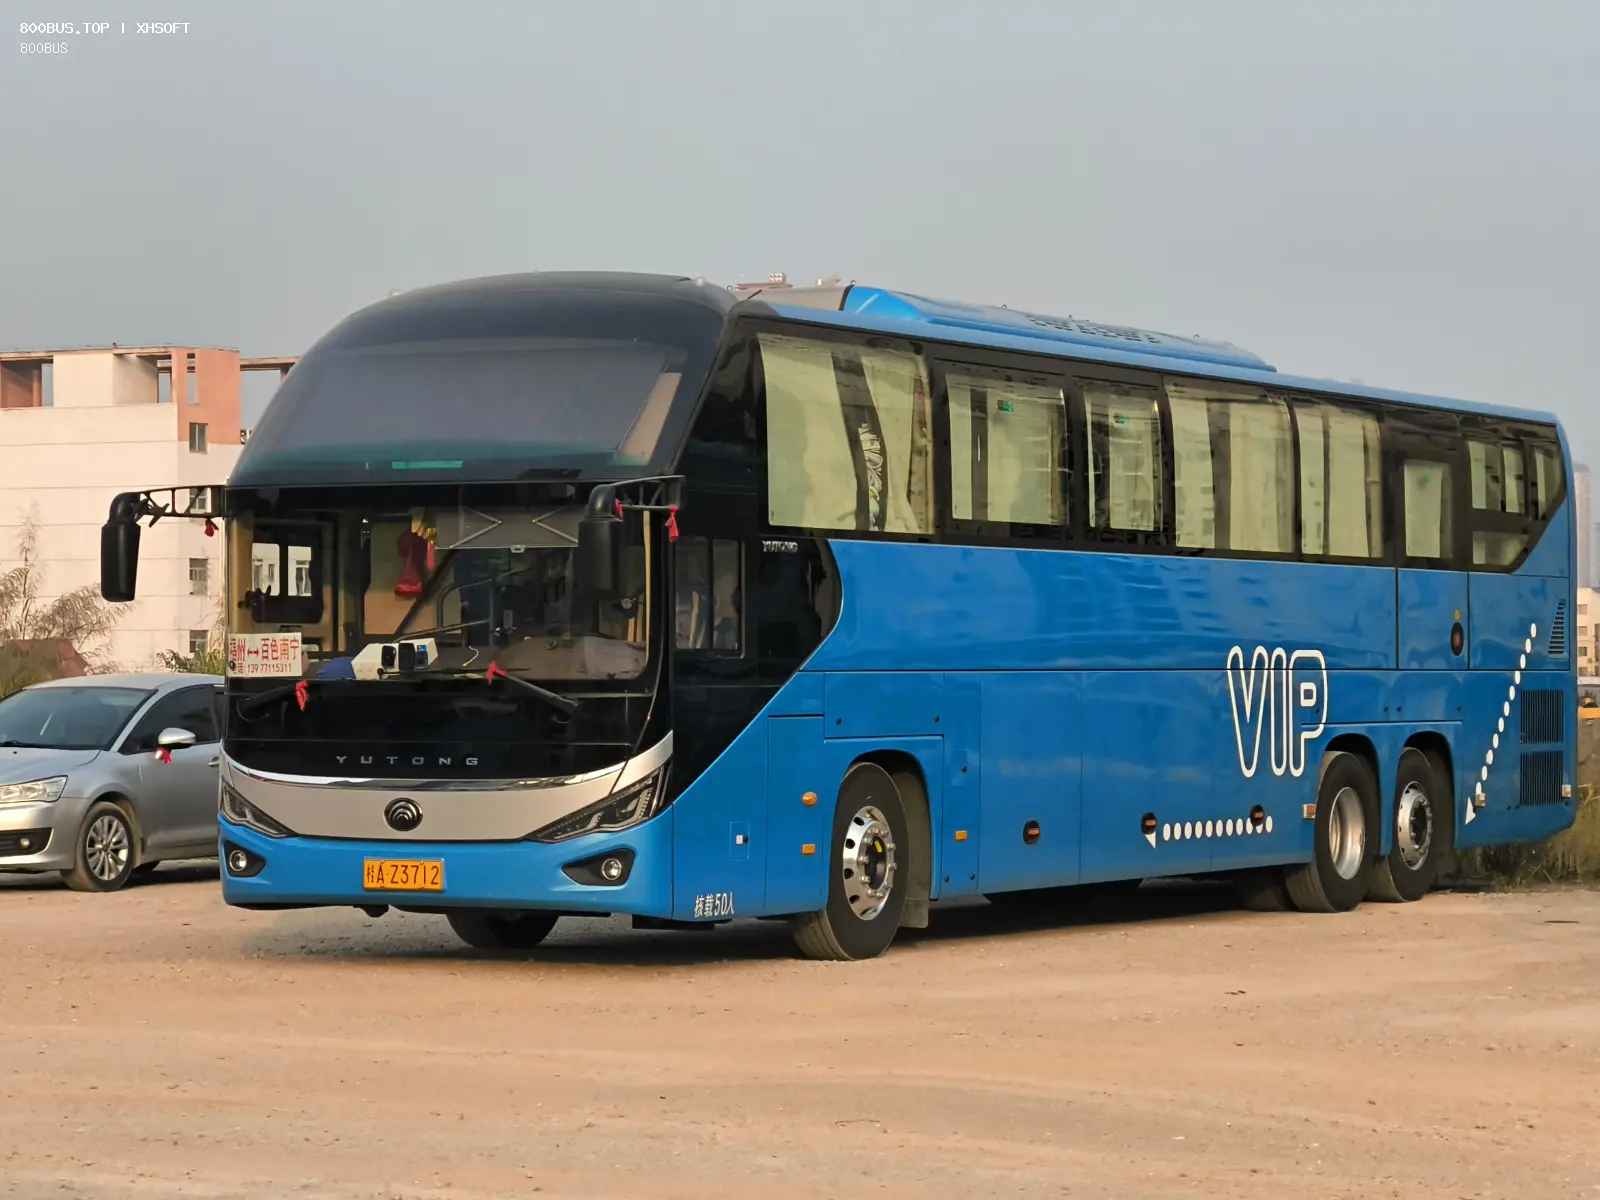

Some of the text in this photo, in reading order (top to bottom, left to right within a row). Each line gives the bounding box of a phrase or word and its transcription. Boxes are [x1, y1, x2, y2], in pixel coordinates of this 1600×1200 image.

[762, 540, 798, 553] YUTONG
[261, 636, 299, 661] 百色南宁
[1227, 645, 1328, 778] VIP
[336, 755, 479, 766] YUTONG
[695, 891, 734, 918] 核载50人
